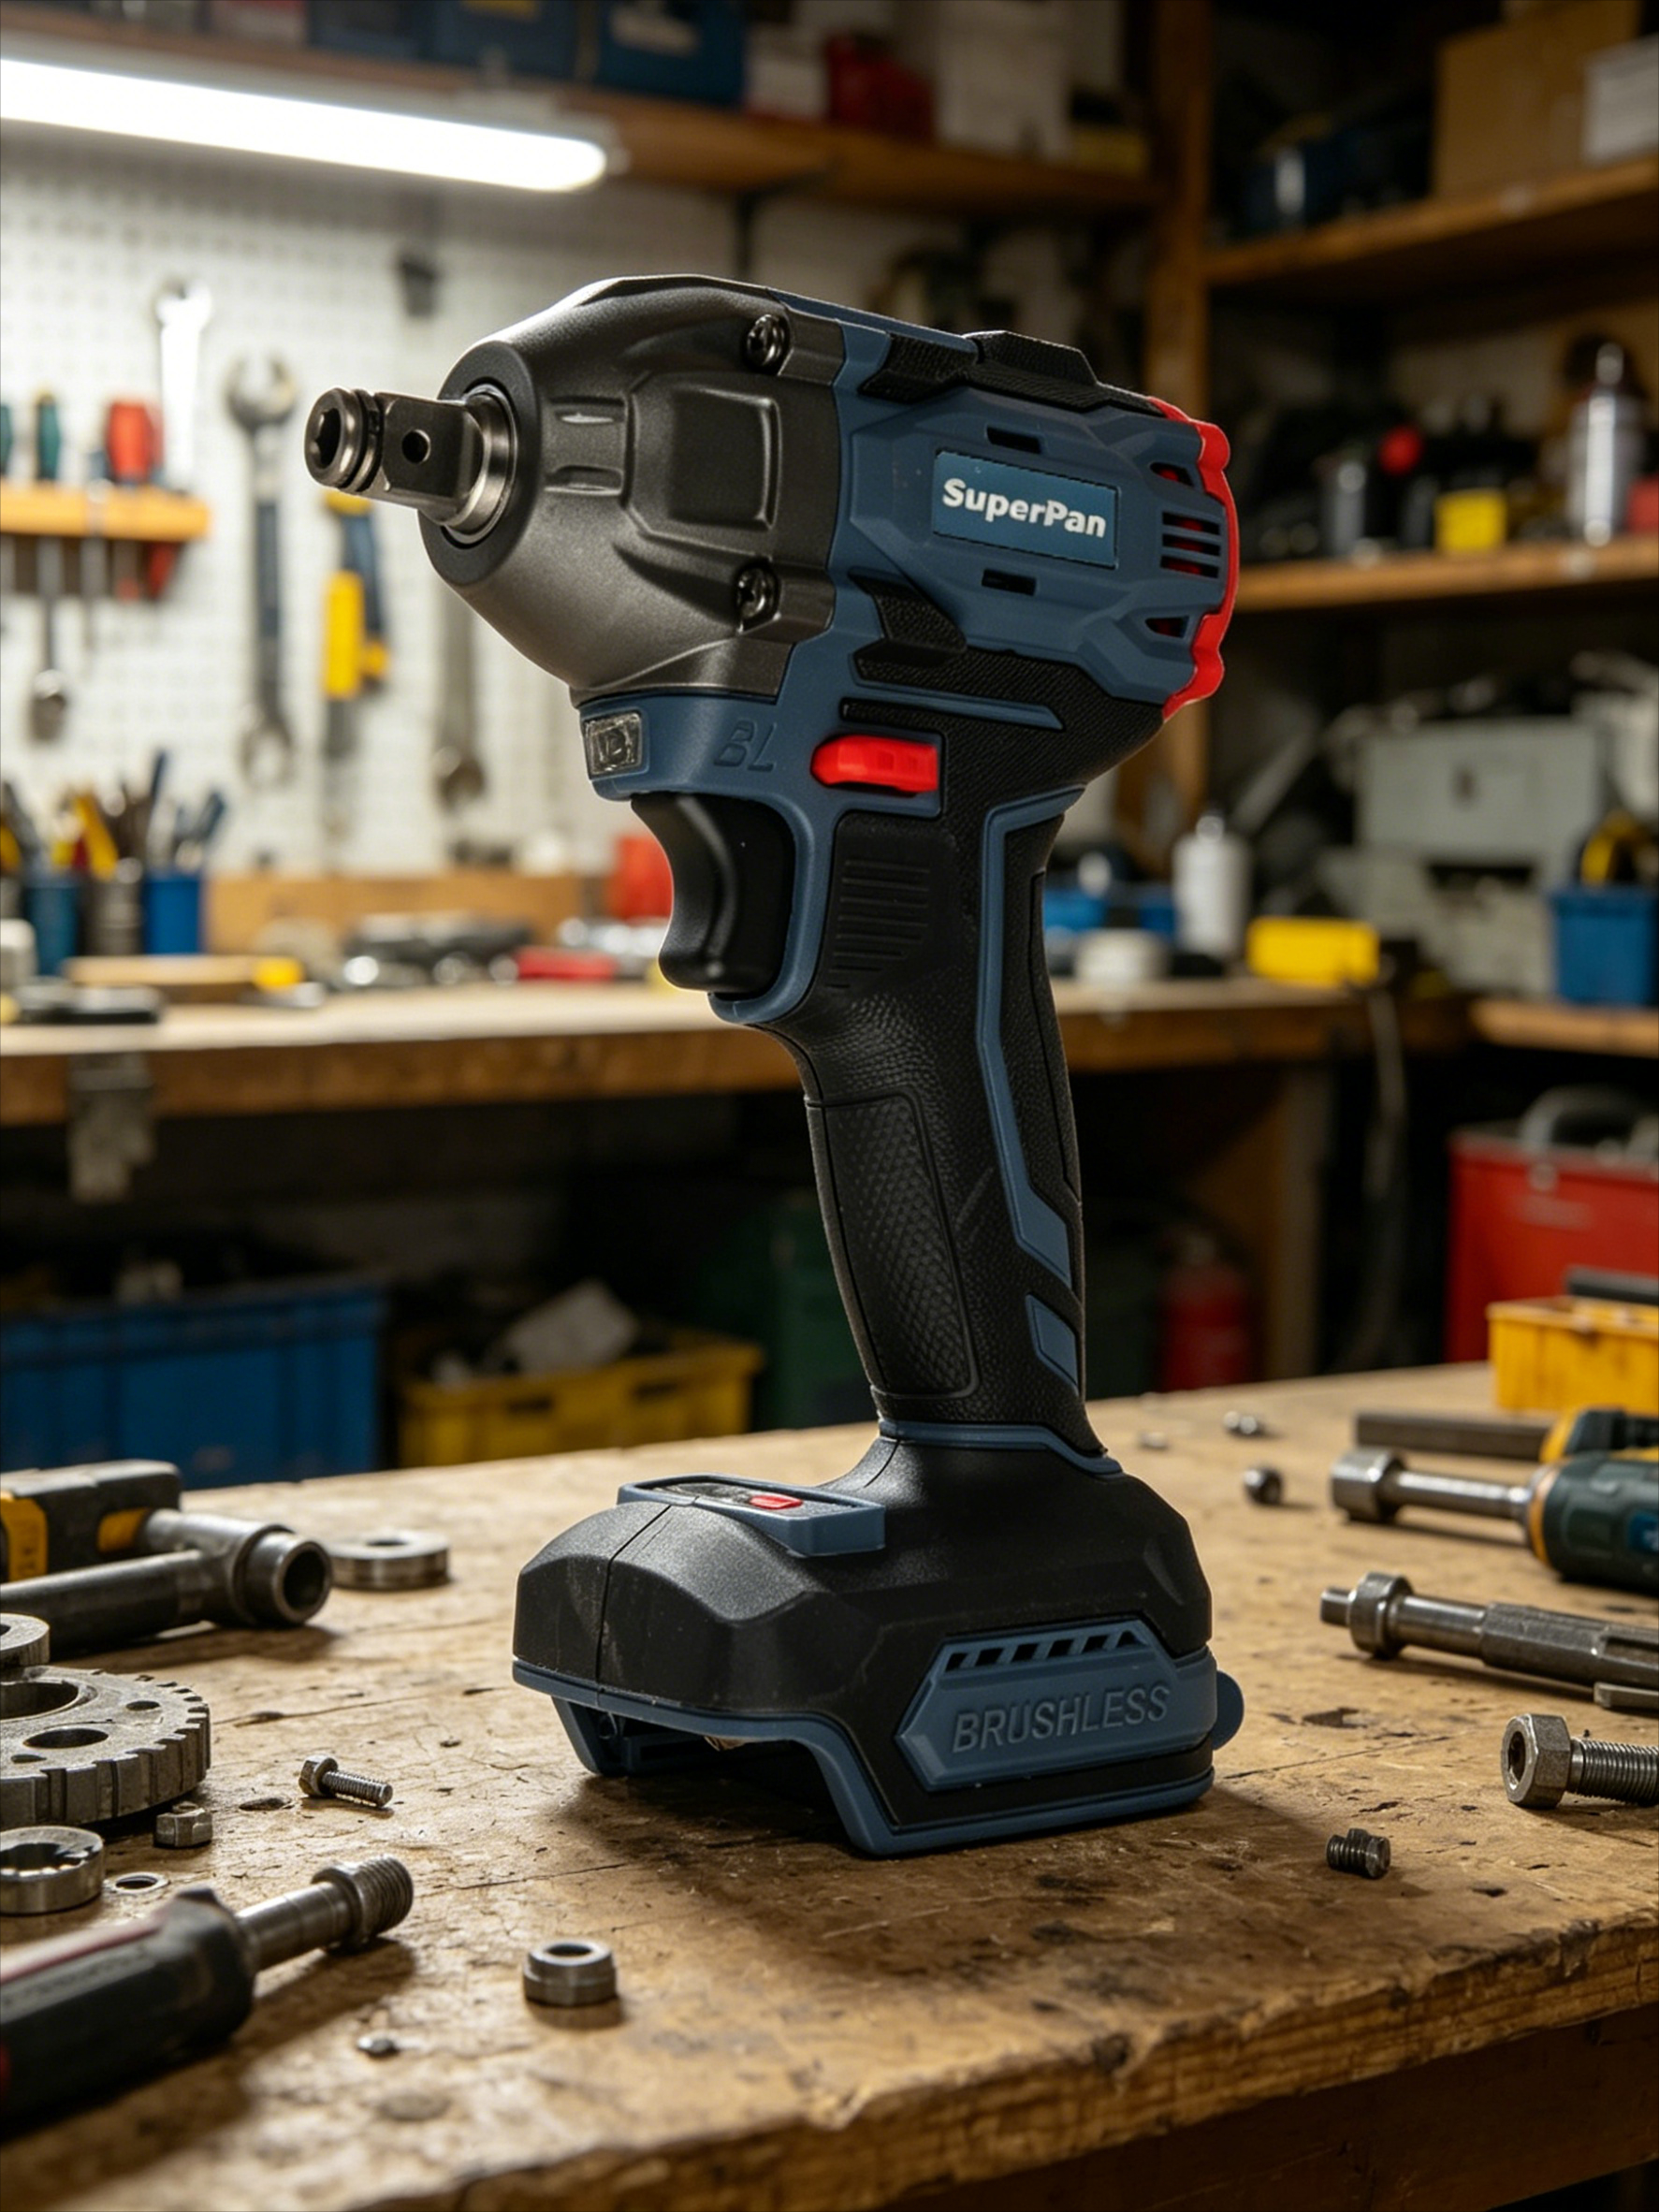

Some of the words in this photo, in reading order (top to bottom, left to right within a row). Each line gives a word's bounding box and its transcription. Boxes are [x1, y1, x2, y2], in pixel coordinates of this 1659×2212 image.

[942, 478, 1106, 537] SuperPan
[714, 720, 776, 772] BL
[953, 1684, 1170, 1753] BRUSHLESS
